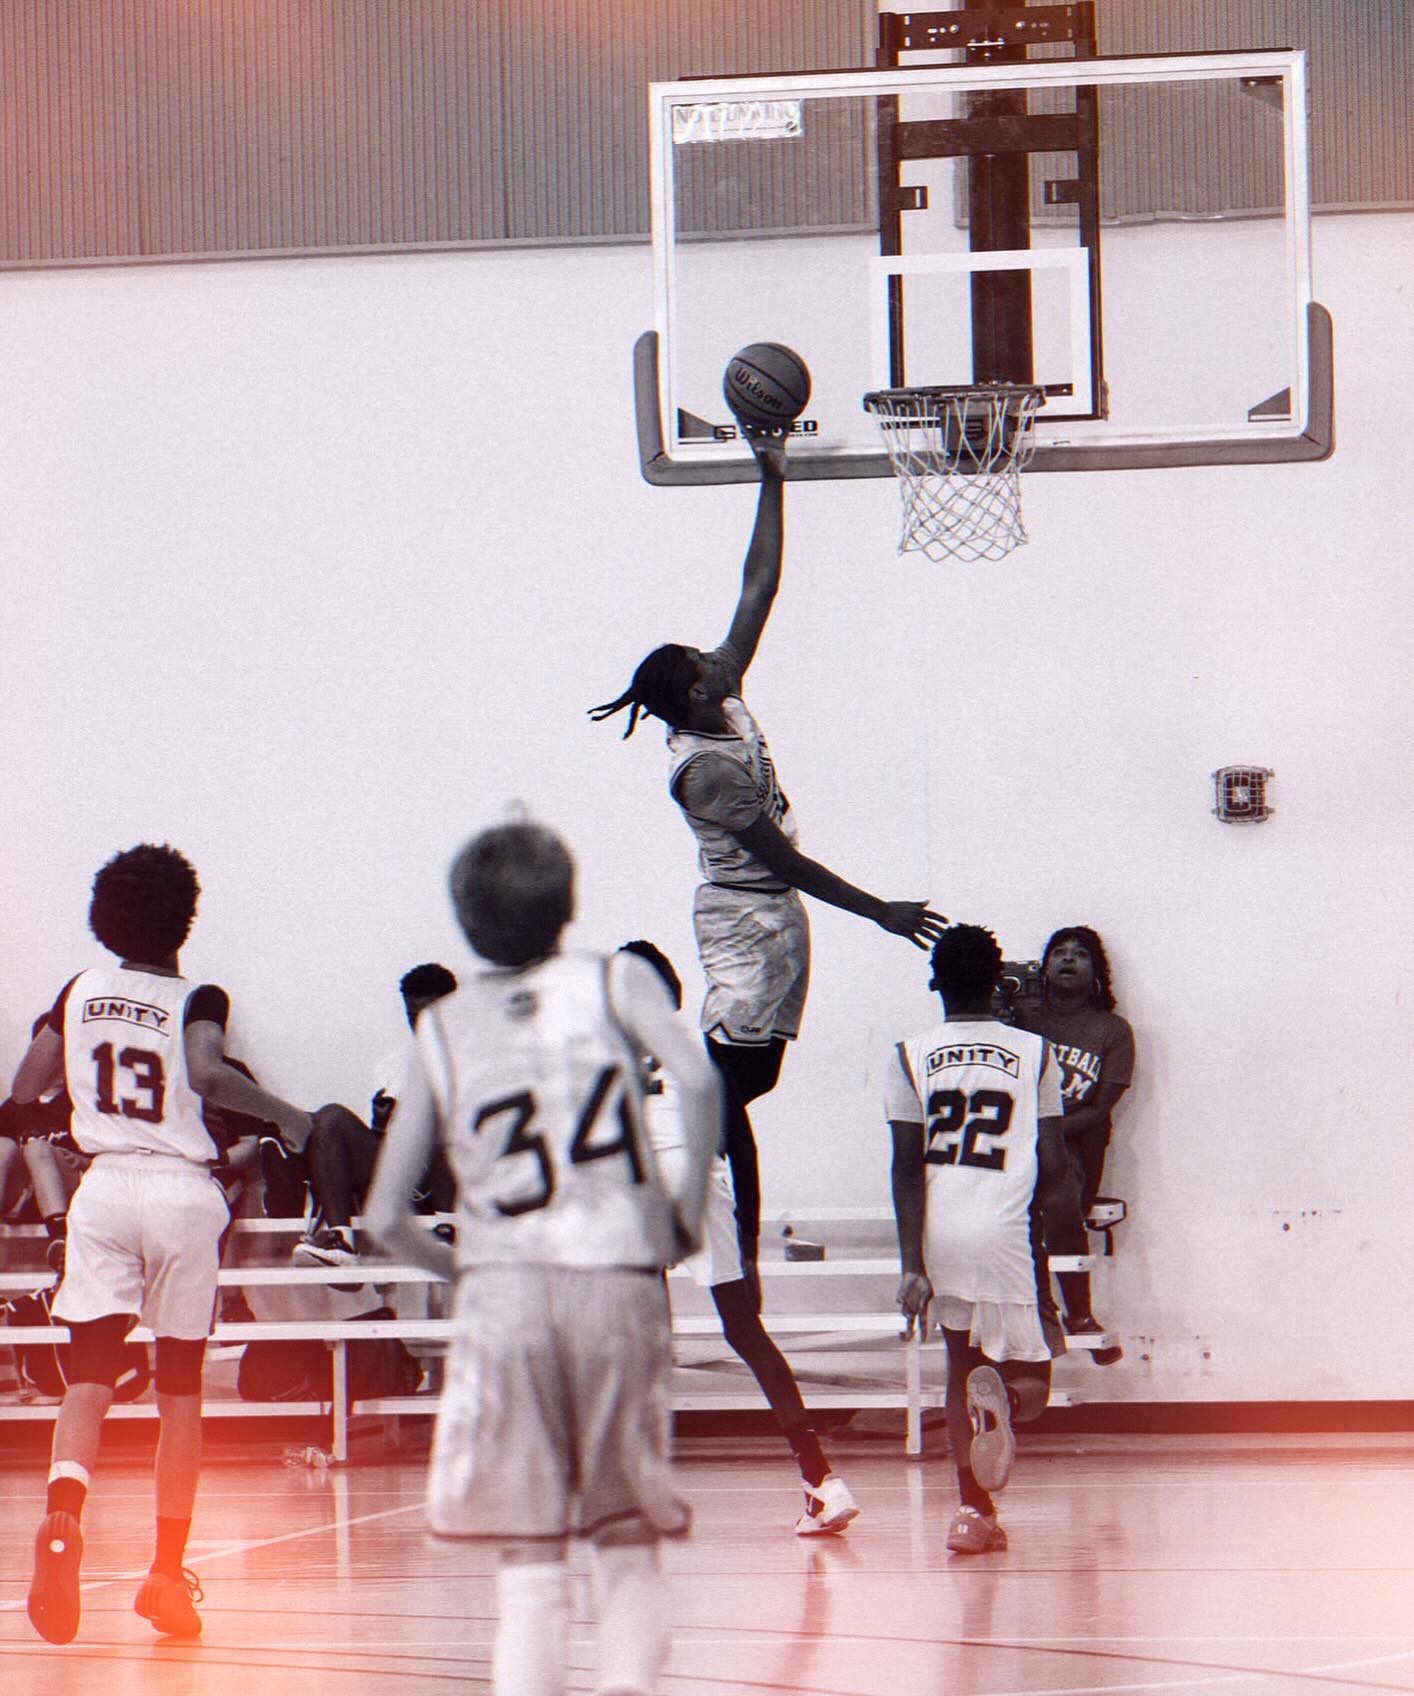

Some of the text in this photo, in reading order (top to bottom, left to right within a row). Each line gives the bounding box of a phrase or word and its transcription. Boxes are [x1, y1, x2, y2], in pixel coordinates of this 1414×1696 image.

[735, 367, 783, 410] Wilson
[88, 1002, 168, 1027] UNITY
[92, 1042, 165, 1123] 13
[929, 1049, 1015, 1069] UNITY
[474, 1063, 646, 1216] 34
[925, 1089, 1014, 1171] 22
